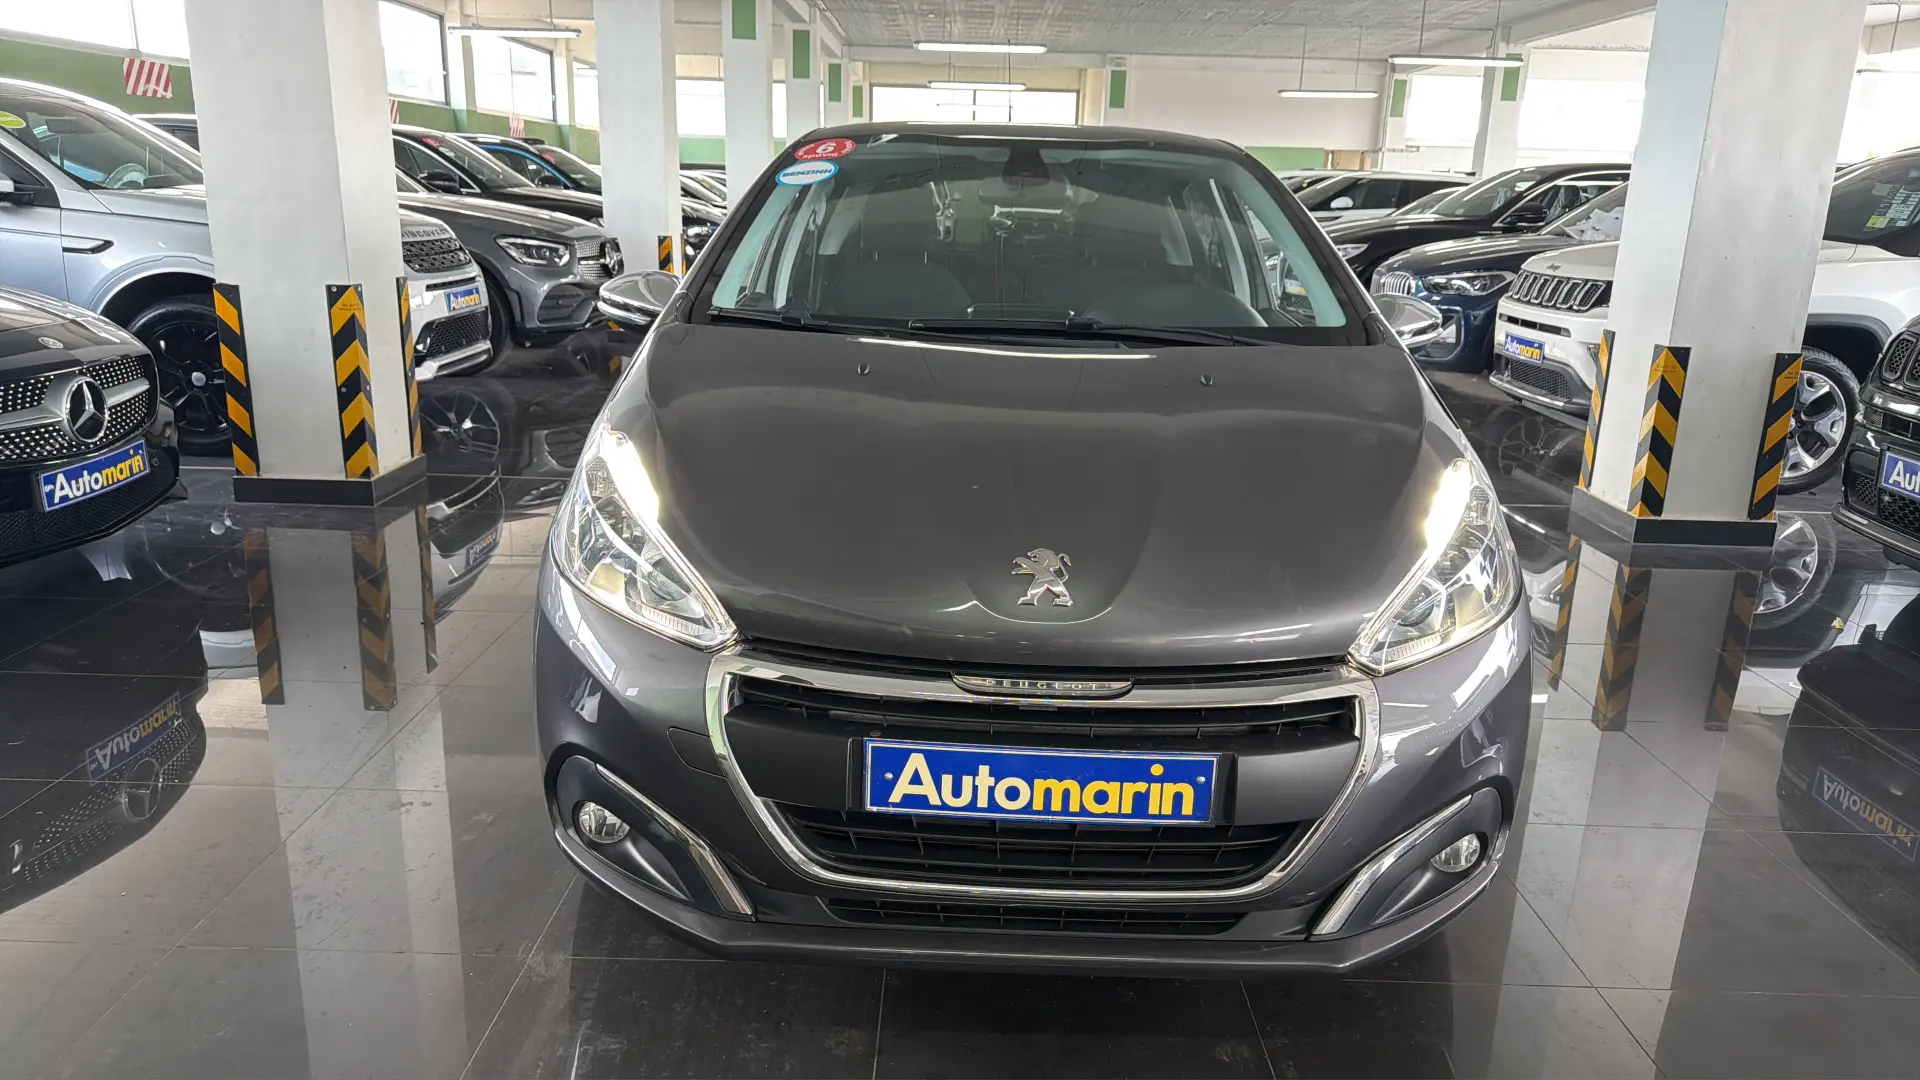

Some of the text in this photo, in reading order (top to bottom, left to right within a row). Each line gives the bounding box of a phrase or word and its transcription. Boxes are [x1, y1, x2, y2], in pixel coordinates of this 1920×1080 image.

[816, 142, 836, 153] 6
[1505, 336, 1541, 360] Automarin
[54, 449, 144, 504] Automarin
[986, 680, 1096, 690] PEUGEOT
[888, 752, 1195, 816] Automarin
